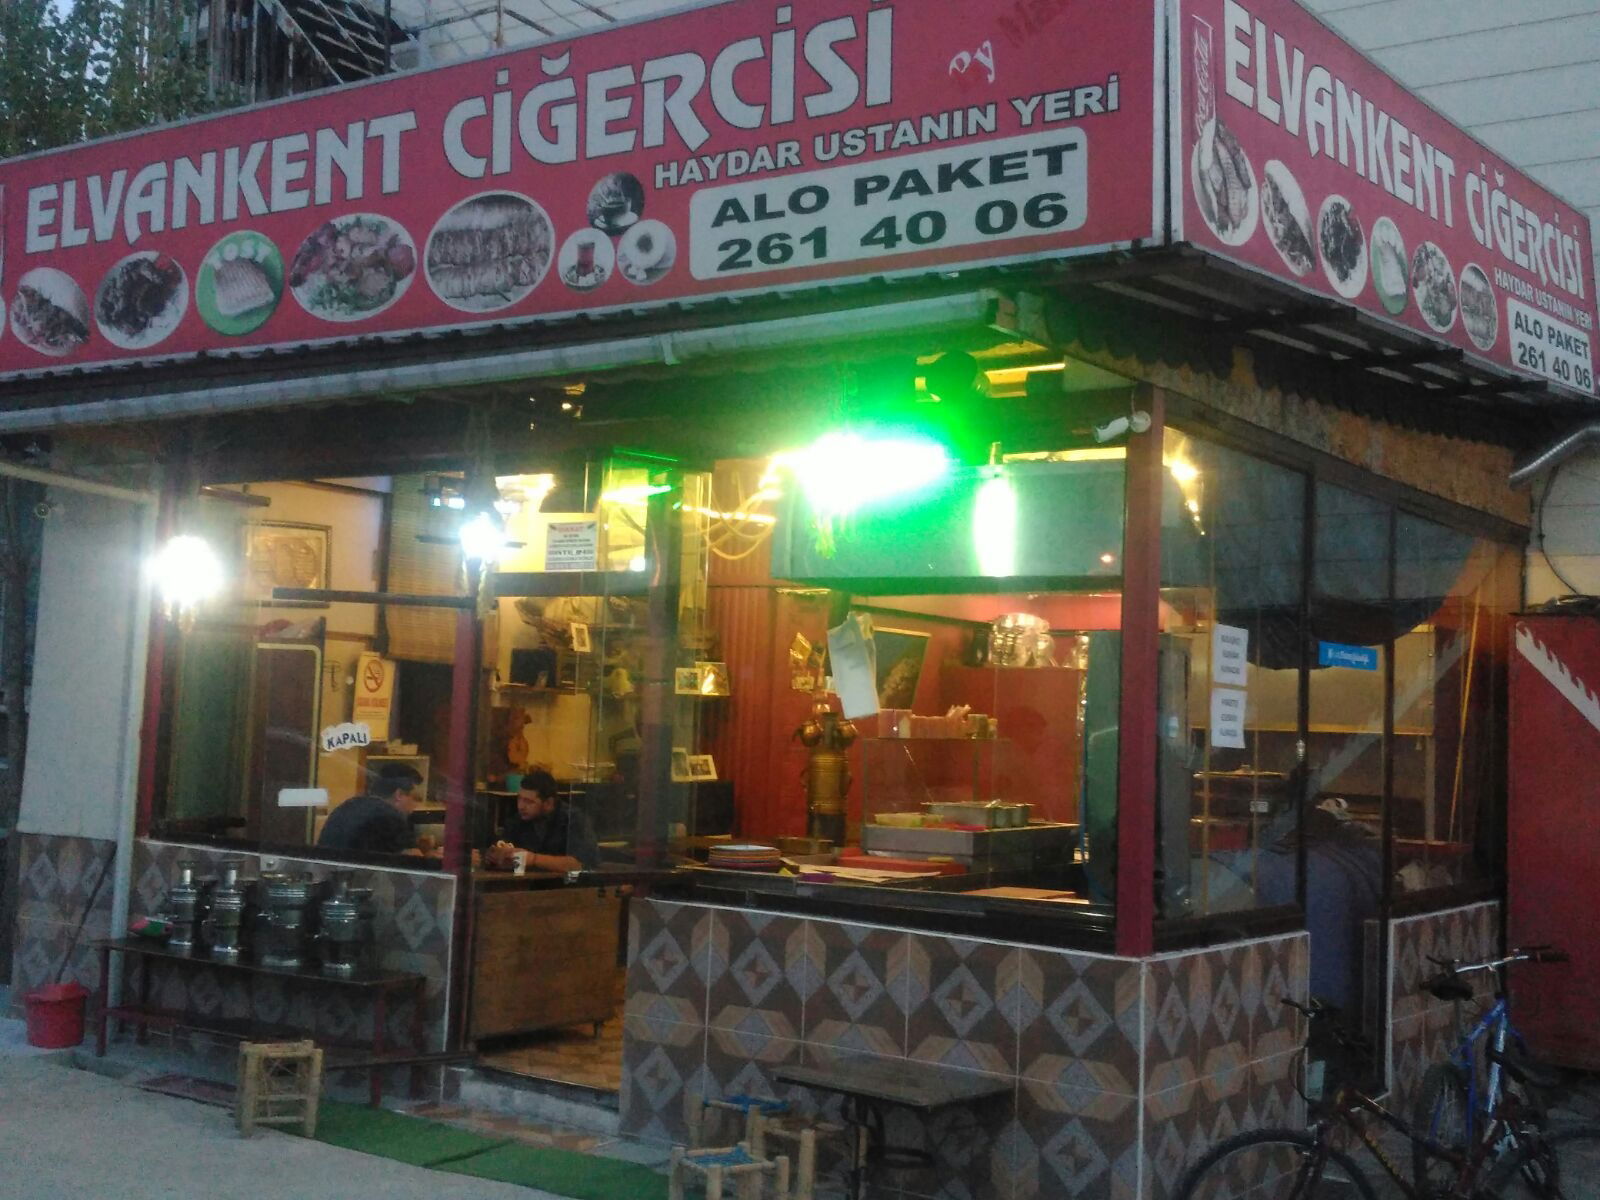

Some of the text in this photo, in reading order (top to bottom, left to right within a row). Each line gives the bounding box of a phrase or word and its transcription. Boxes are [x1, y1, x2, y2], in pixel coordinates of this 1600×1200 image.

[26, 0, 893, 254] ELVANKENT CİĞERCİSİ
[654, 74, 1120, 189] HAYDAR USTANIN YERİ
[1223, 0, 1585, 300] ELVANKENT CİĞERCİSİ
[711, 142, 1078, 228] ALO PAKET
[716, 192, 1069, 272] 261 40 06
[1494, 266, 1534, 302] HAYDAR
[1515, 310, 1588, 360] ALO PAKET
[1518, 342, 1591, 389] 261 40 06
[326, 732, 368, 750] KAPALI
